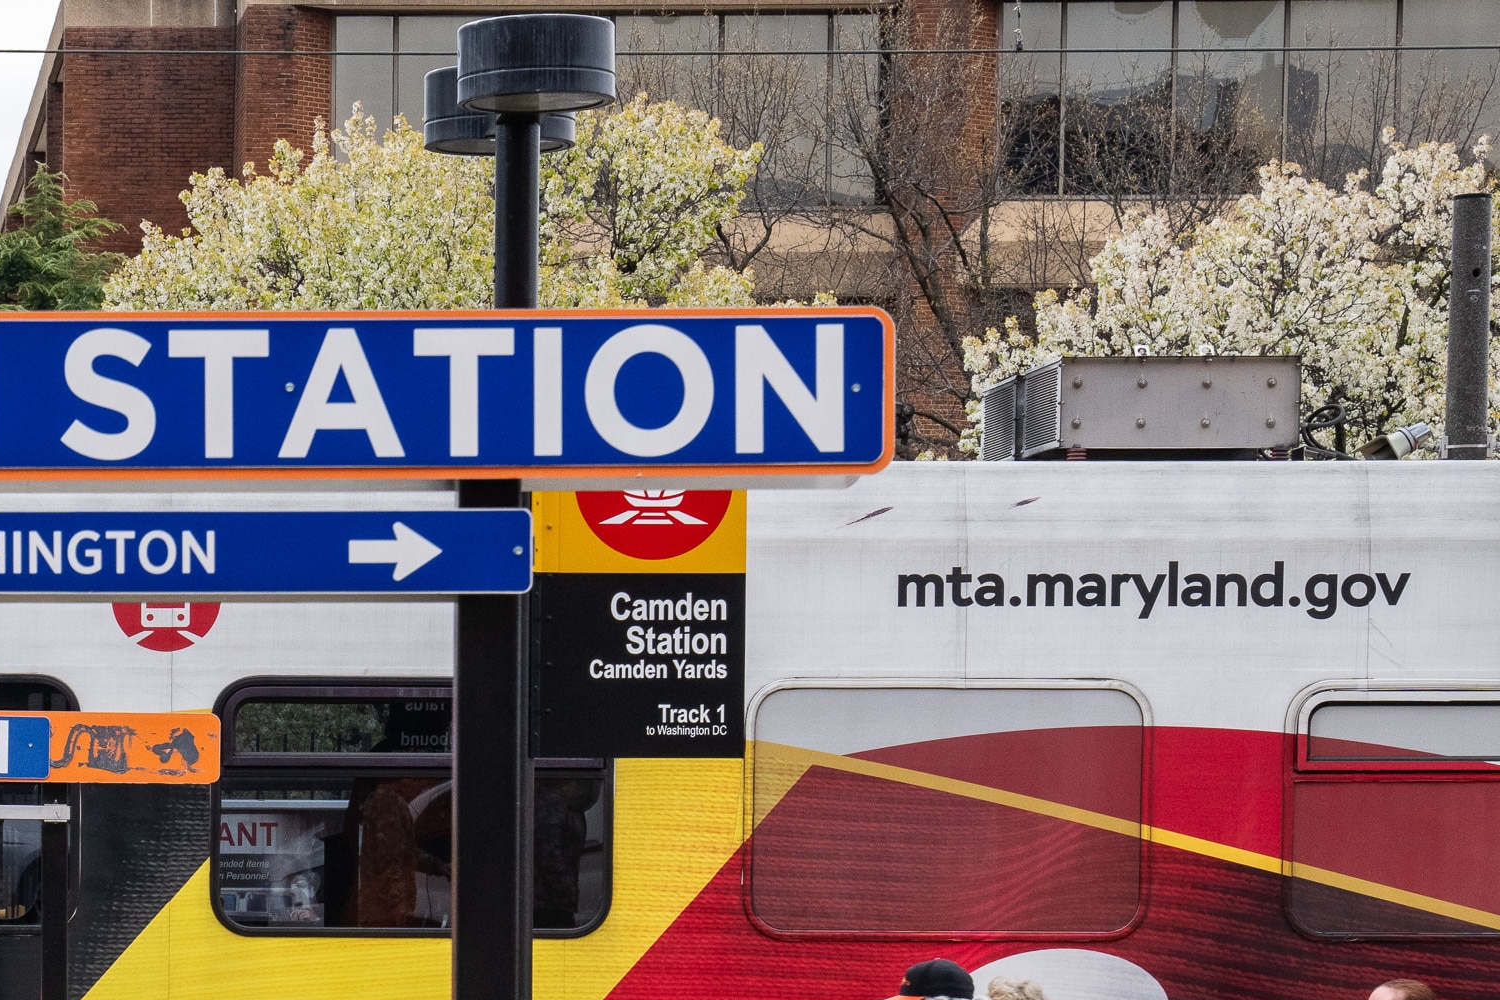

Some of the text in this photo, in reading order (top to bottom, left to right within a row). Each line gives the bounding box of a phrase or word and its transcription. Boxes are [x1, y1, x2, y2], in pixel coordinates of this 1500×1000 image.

[60, 323, 845, 460] STATION
[897, 560, 1412, 620] mta.maryland.gov
[611, 592, 727, 621] Camden
[626, 626, 727, 655] Station
[589, 659, 728, 679] Camden Yards
[657, 704, 726, 723] Track 1
[646, 724, 728, 739] to Washington DC
[246, 859, 270, 869] items
